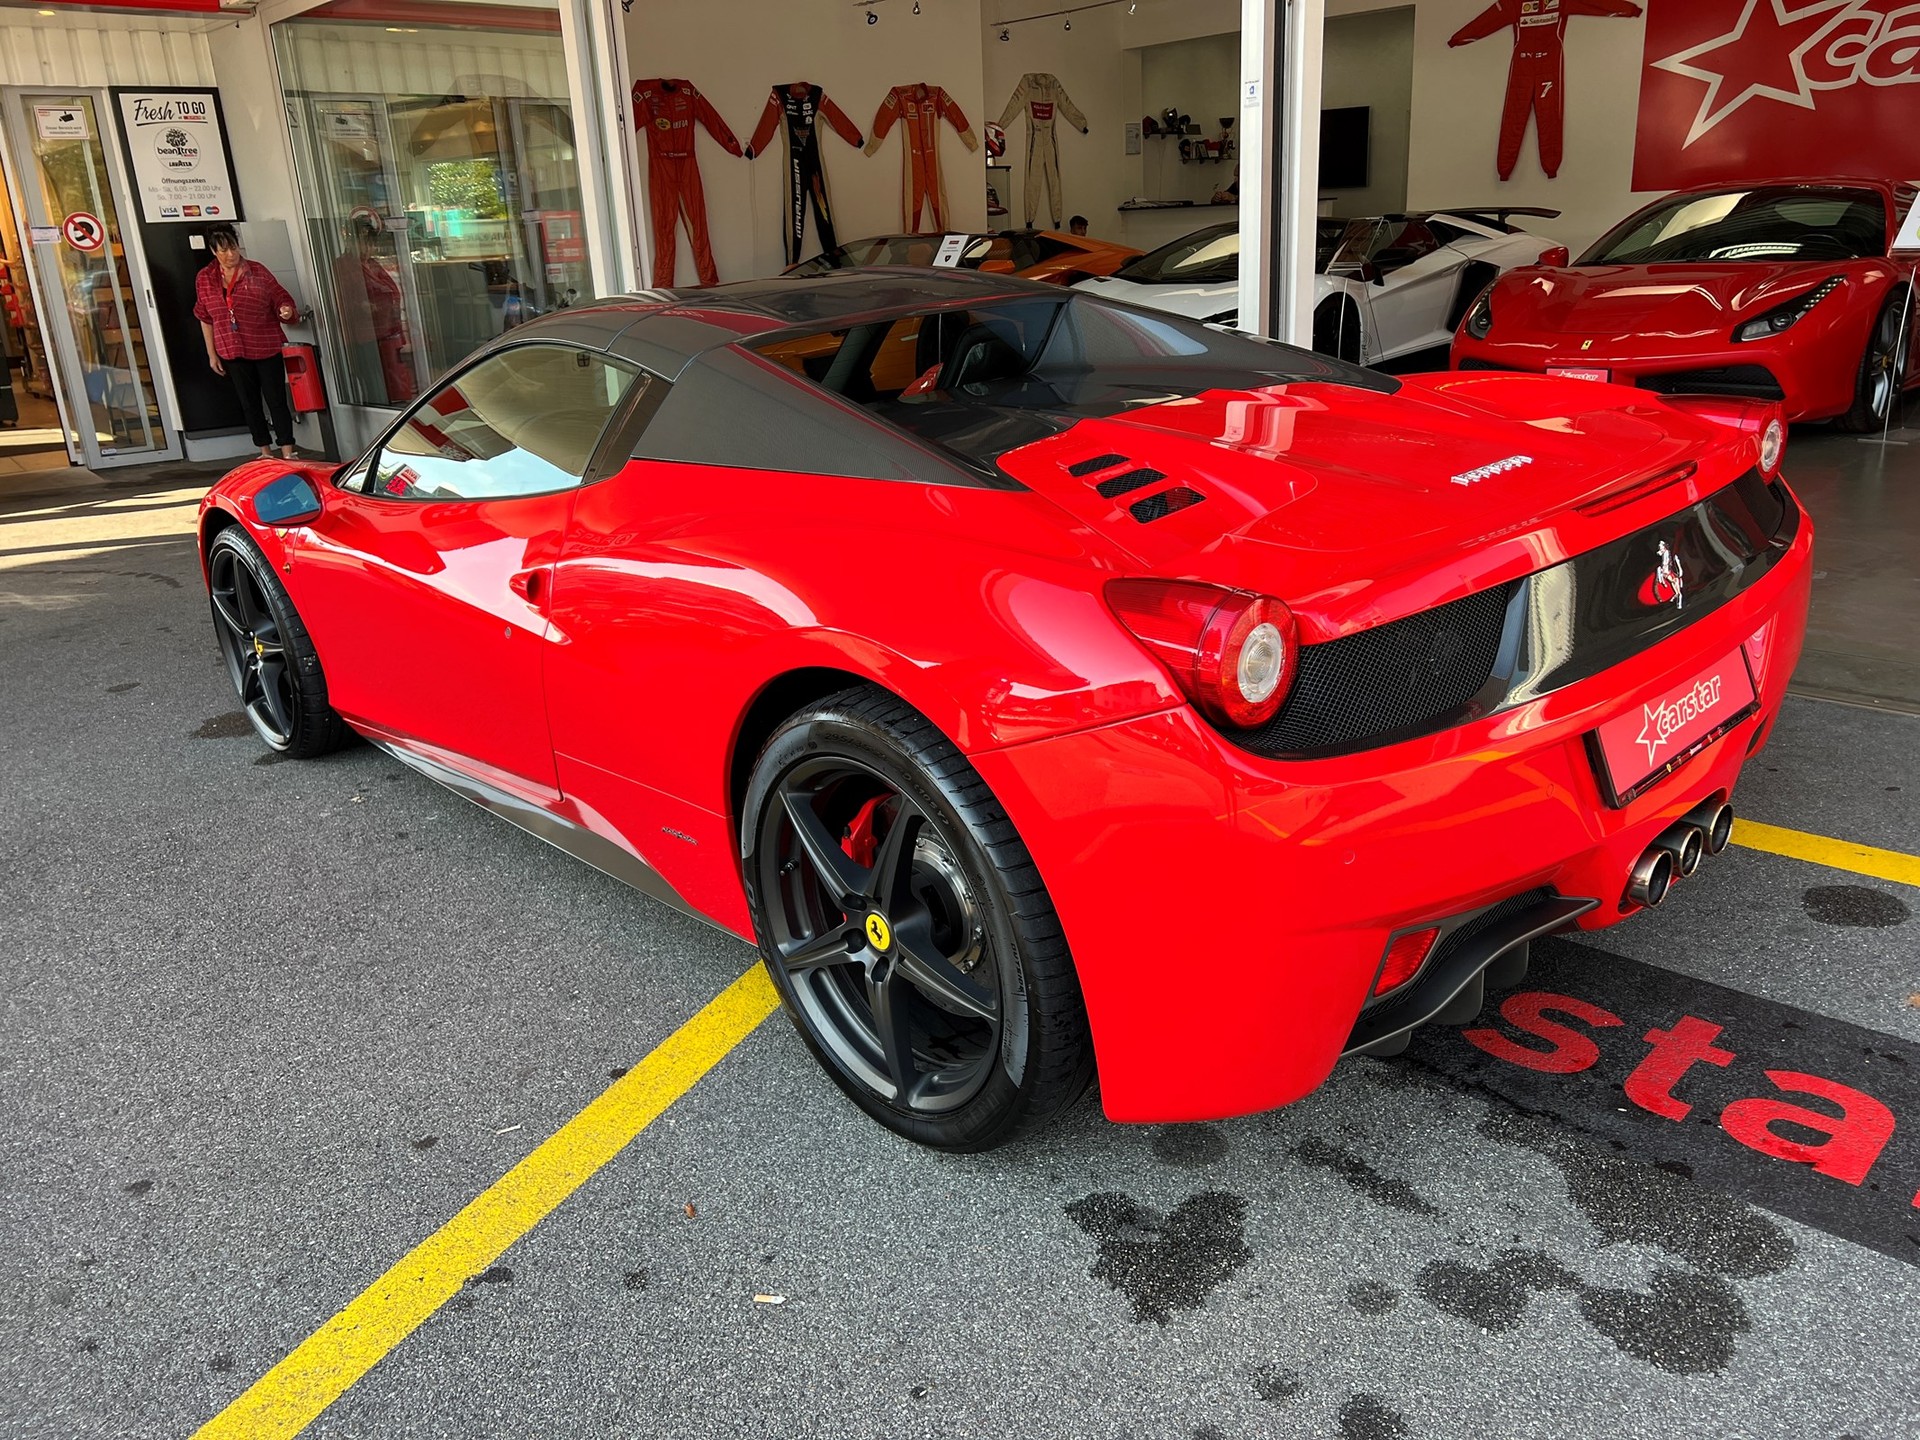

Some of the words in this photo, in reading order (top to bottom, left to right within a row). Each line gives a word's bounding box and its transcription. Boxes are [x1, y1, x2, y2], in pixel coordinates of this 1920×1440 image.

[1541, 81, 1553, 98] 7
[133, 98, 175, 121] Fresh
[175, 101, 190, 115] TO
[191, 101, 206, 115] GO
[161, 177, 206, 185] Öffnungszeiten
[1658, 674, 1721, 739] carstar
[1462, 990, 1920, 1209] sta
